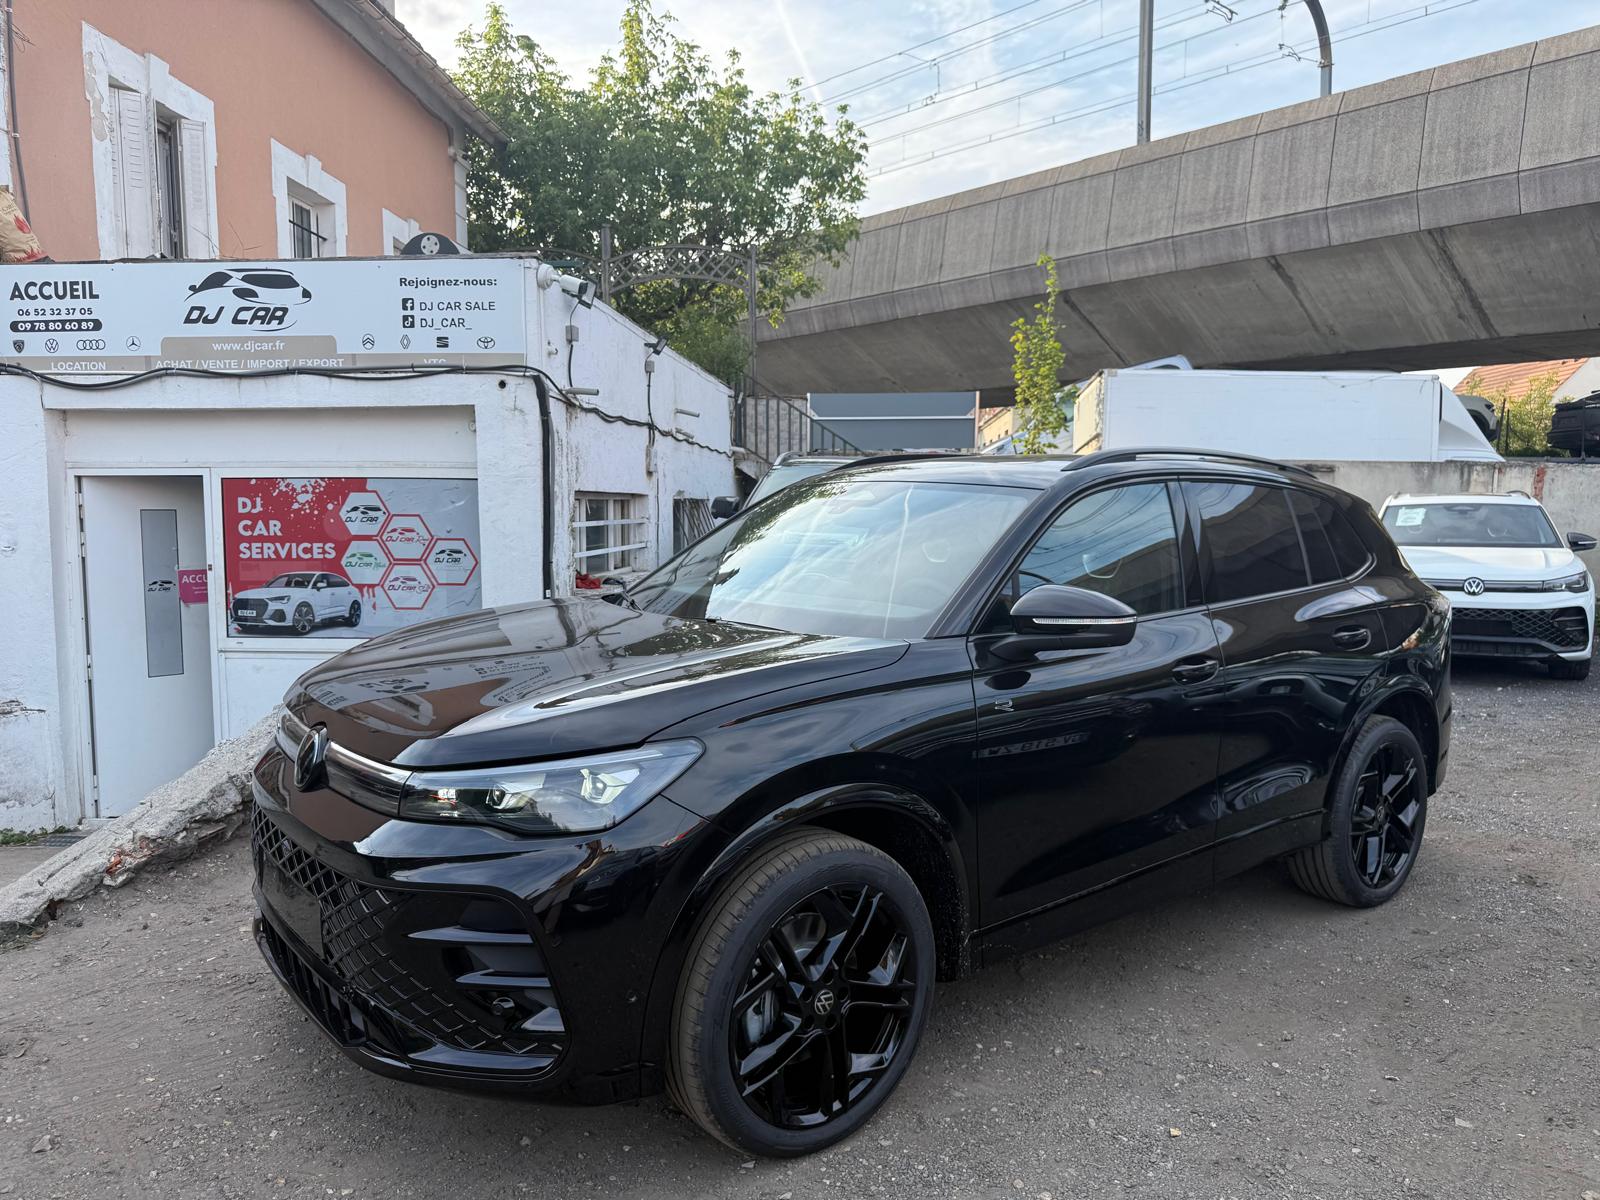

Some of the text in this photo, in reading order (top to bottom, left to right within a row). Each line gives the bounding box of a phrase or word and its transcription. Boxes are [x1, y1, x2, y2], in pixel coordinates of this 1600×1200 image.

[399, 277, 498, 288] Rejoignez-nous:
[9, 280, 100, 300] ACCUEIL
[17, 307, 93, 316] 06 52 32 37 05
[419, 301, 496, 311] DJ CAR SALE
[183, 306, 289, 325] DJ CAR
[17, 321, 94, 331] 09 78 80 60 89
[420, 318, 473, 330] DJ_CAR_
[212, 340, 285, 353] www.djcar.fr
[51, 361, 106, 371] LOCATION
[155, 360, 193, 369] ACHAT
[201, 359, 238, 369] VENTE
[247, 359, 290, 369] IMPORT
[298, 358, 345, 367] EXPORT
[237, 496, 263, 513] DJ
[238, 520, 282, 536] CAR
[239, 542, 337, 559] SERVICES
